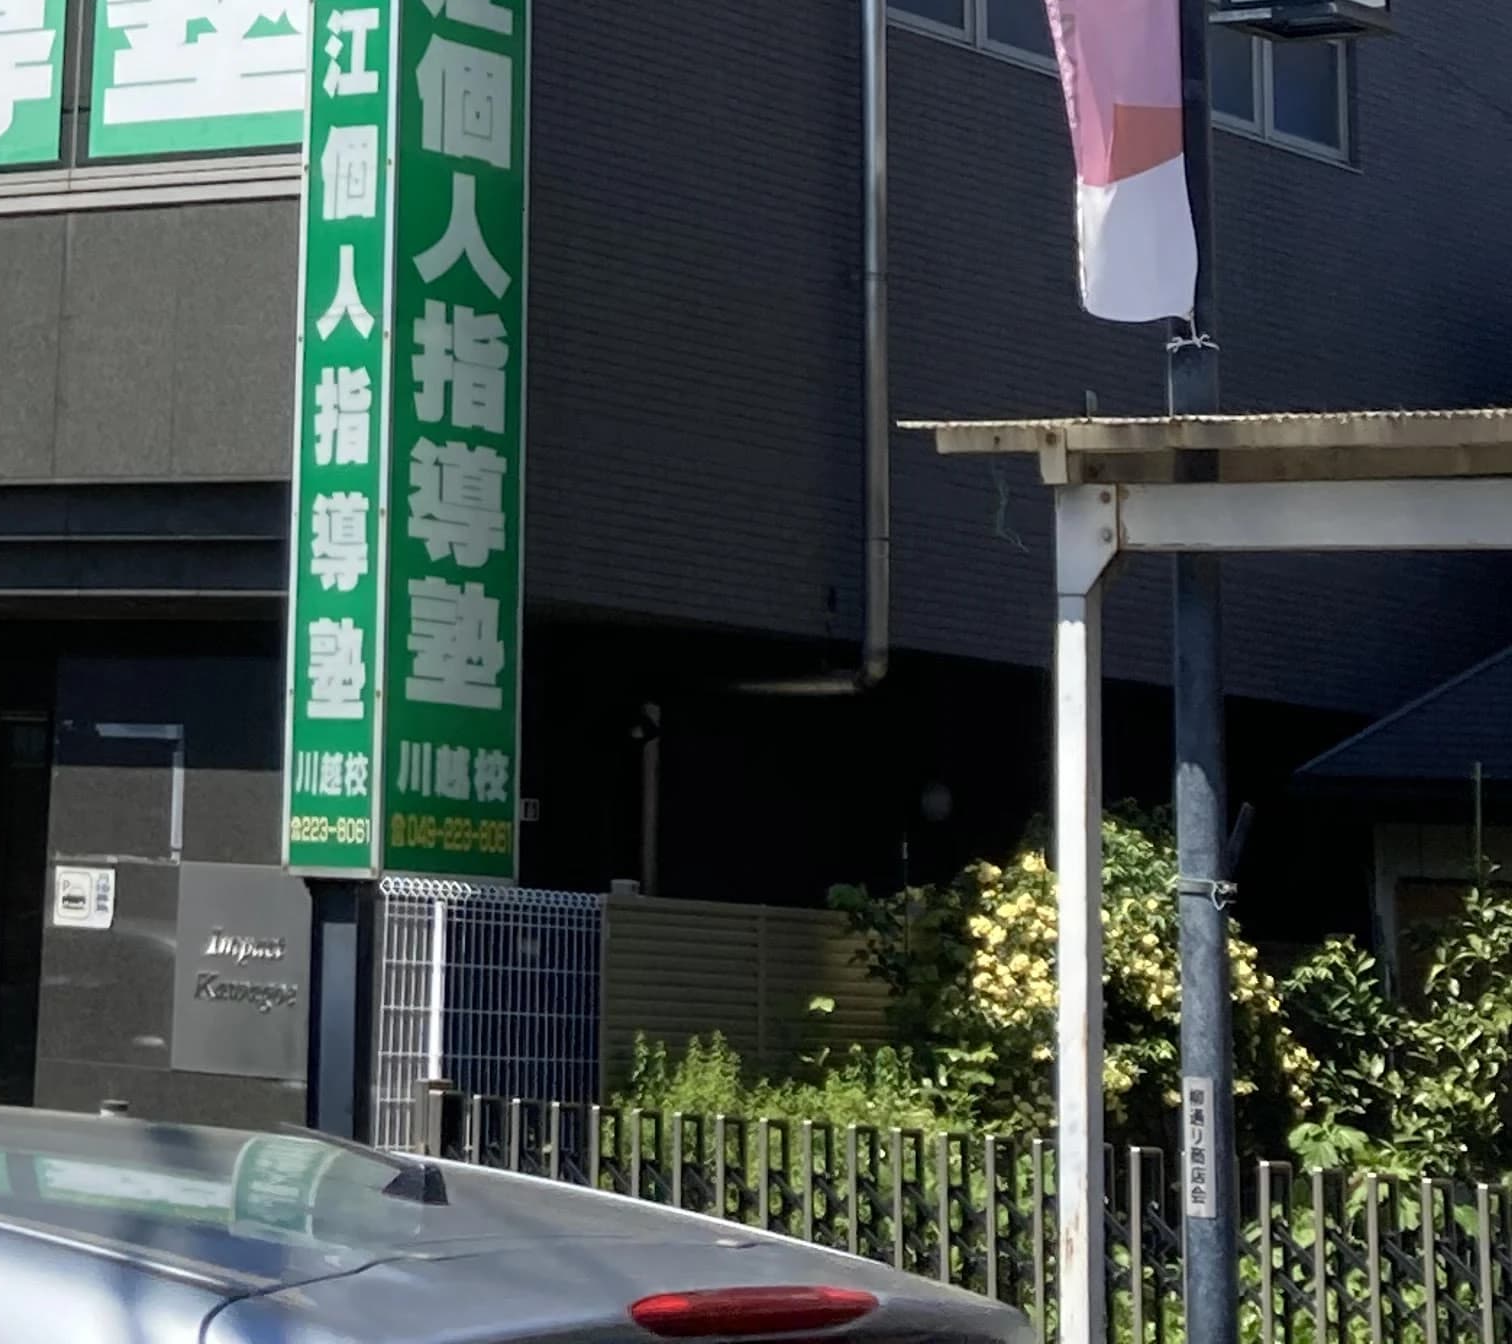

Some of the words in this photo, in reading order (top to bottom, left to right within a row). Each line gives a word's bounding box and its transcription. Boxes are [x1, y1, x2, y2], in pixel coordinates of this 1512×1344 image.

[295, 750, 369, 797] 川越校
[397, 740, 510, 803] 川越校
[302, 816, 371, 845] 223-8061
[408, 815, 512, 855] 049-223-8061
[203, 925, 286, 967] Impact
